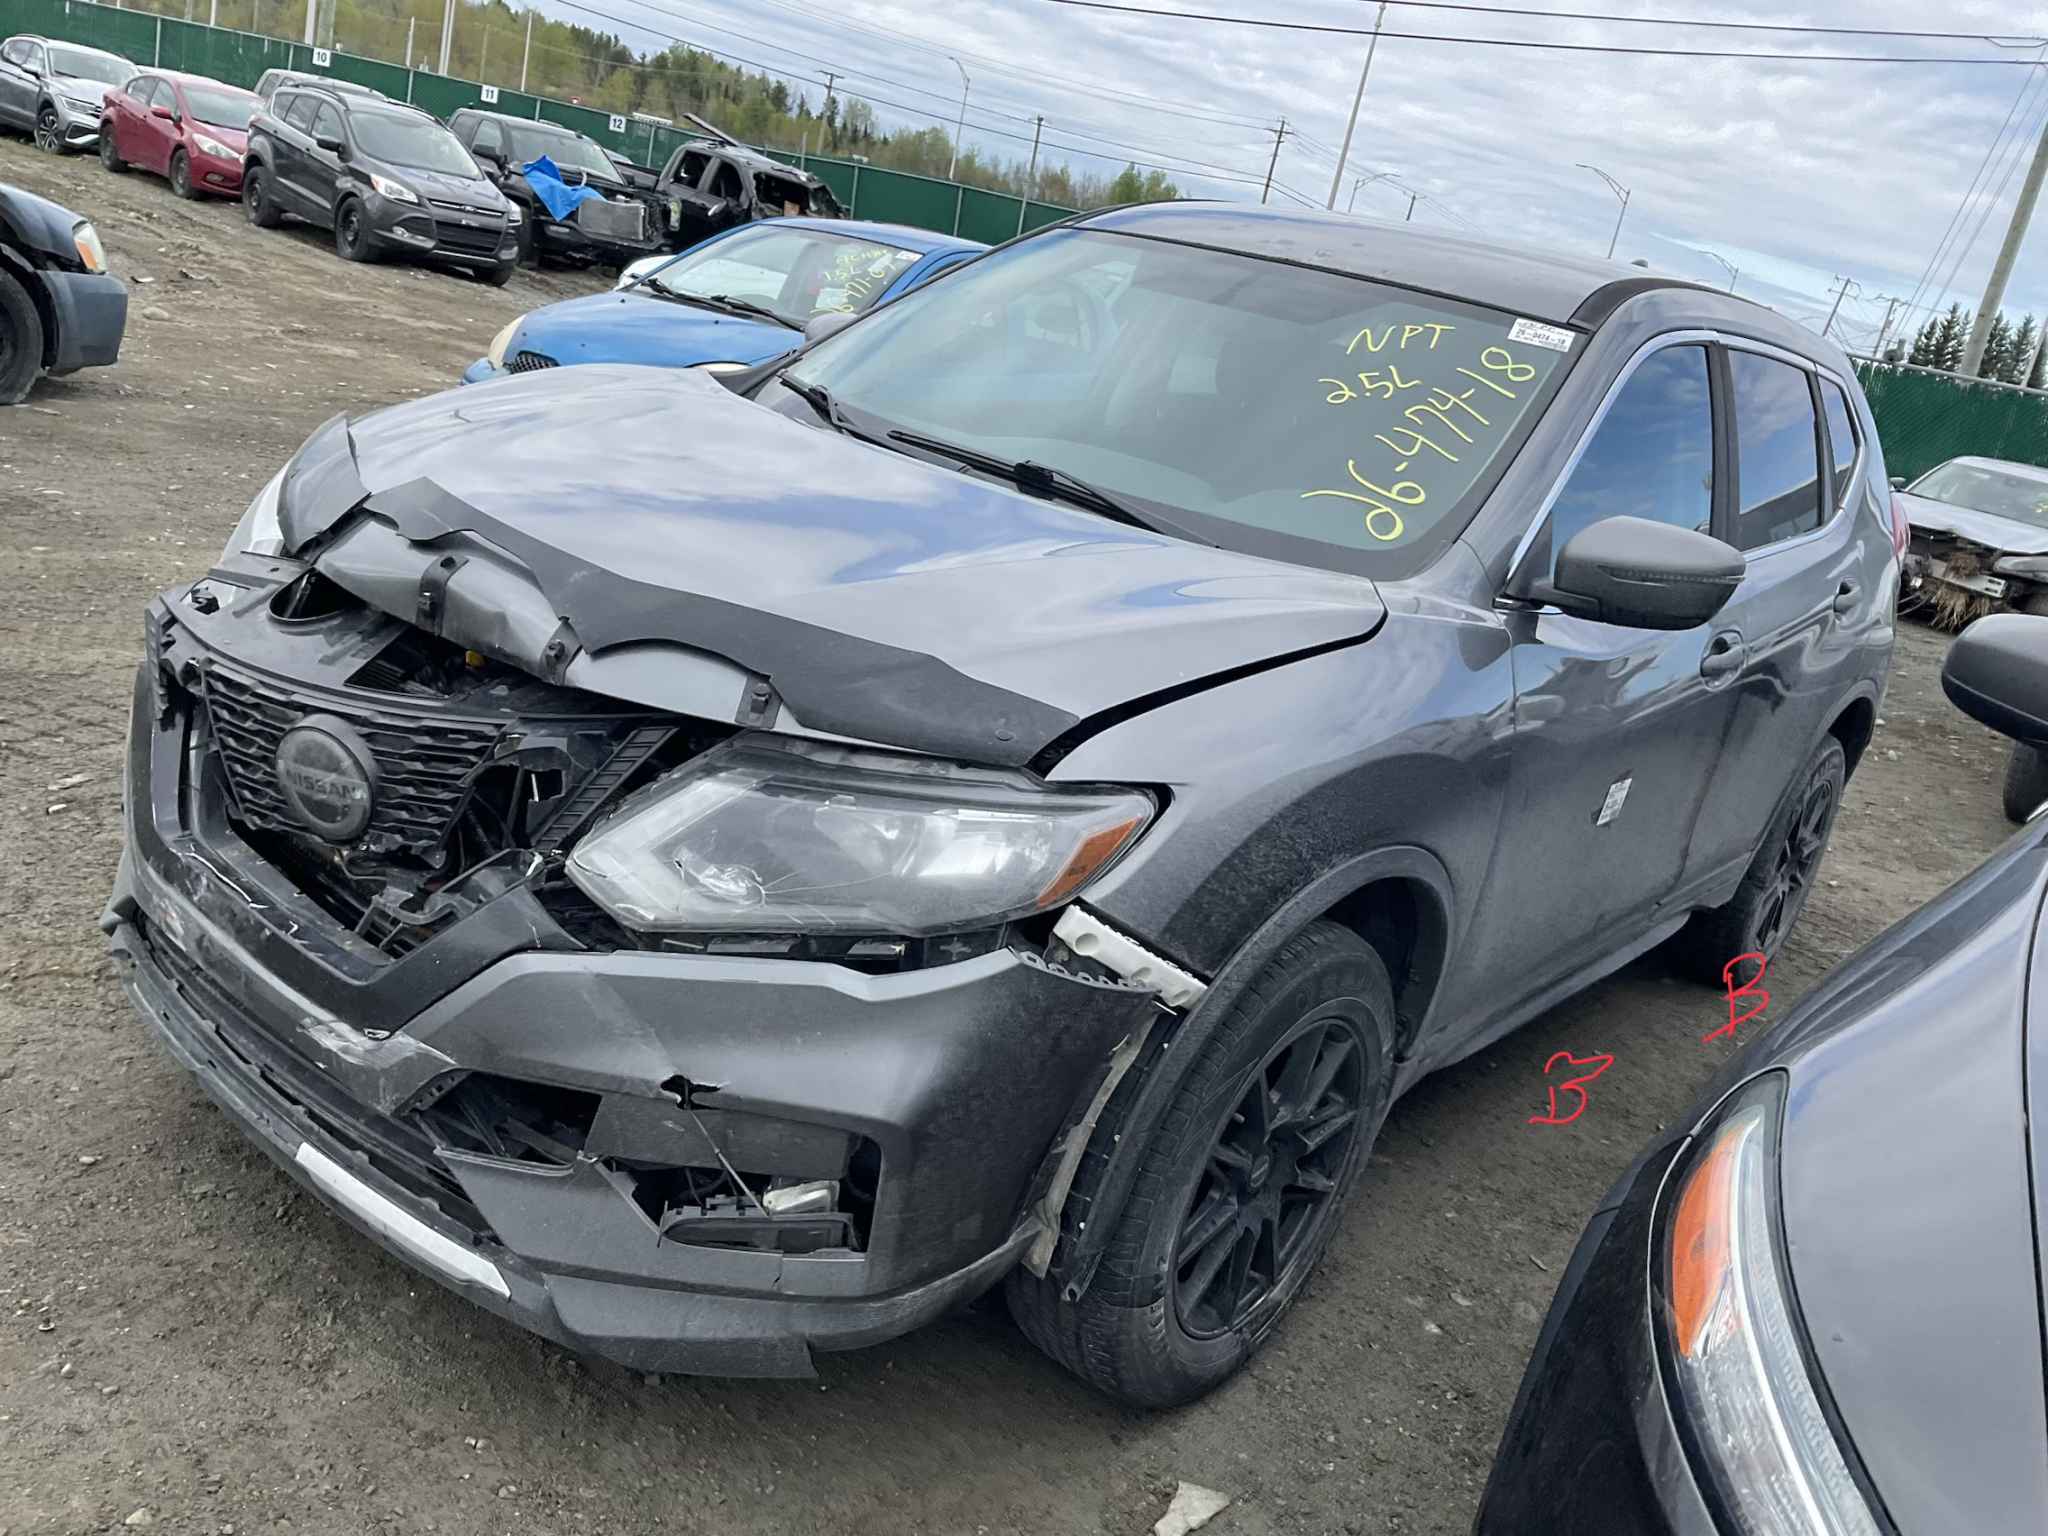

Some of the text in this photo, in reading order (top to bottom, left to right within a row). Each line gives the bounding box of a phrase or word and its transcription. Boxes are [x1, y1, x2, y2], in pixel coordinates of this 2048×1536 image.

[315, 51, 327, 63] 10
[486, 89, 494, 100] 11
[612, 118, 623, 129] 12
[1346, 323, 1456, 355] NPT
